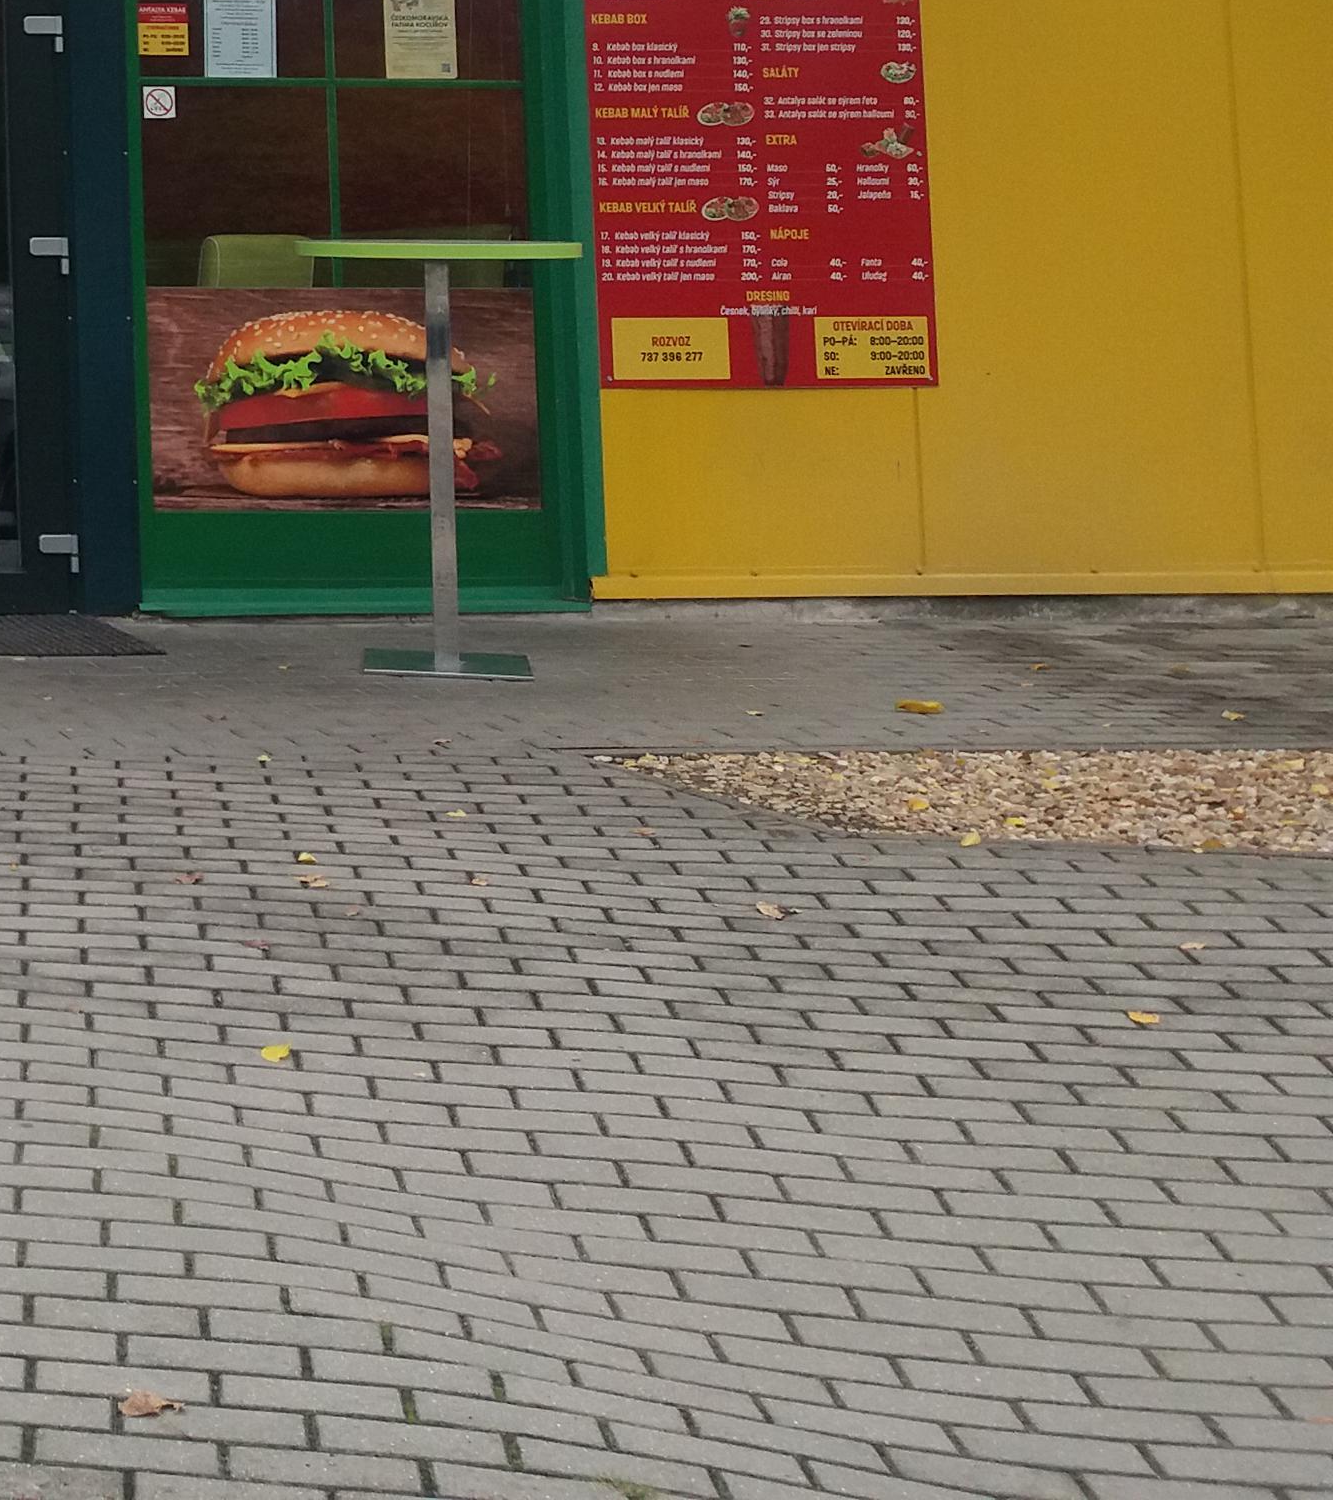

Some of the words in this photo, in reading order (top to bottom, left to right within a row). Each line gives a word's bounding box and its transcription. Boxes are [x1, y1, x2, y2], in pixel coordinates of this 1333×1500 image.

[591, 14, 624, 24] KEBAB
[627, 14, 647, 24] BOX
[607, 43, 630, 51] Kebab
[763, 65, 799, 78] SALÁTY
[595, 108, 629, 118] KEBAB
[631, 105, 658, 118] MALÝ
[662, 105, 690, 118] TALÍŘ
[765, 135, 797, 145] EXTRA
[599, 202, 633, 212] KEBAB
[635, 199, 665, 212] VELKÝ
[668, 199, 697, 212] TALÍŘ
[770, 226, 809, 240] NÁPOJE
[746, 291, 790, 301] DRESING
[833, 318, 883, 331] OTEVÍRACÍ
[886, 321, 913, 331] DOBA
[651, 336, 691, 347] ROZVOZ
[641, 352, 658, 362] 737
[685, 352, 703, 362] 277
[824, 351, 839, 361] SO:
[825, 366, 839, 376] NE:
[885, 364, 925, 375] ZAVŘENO
